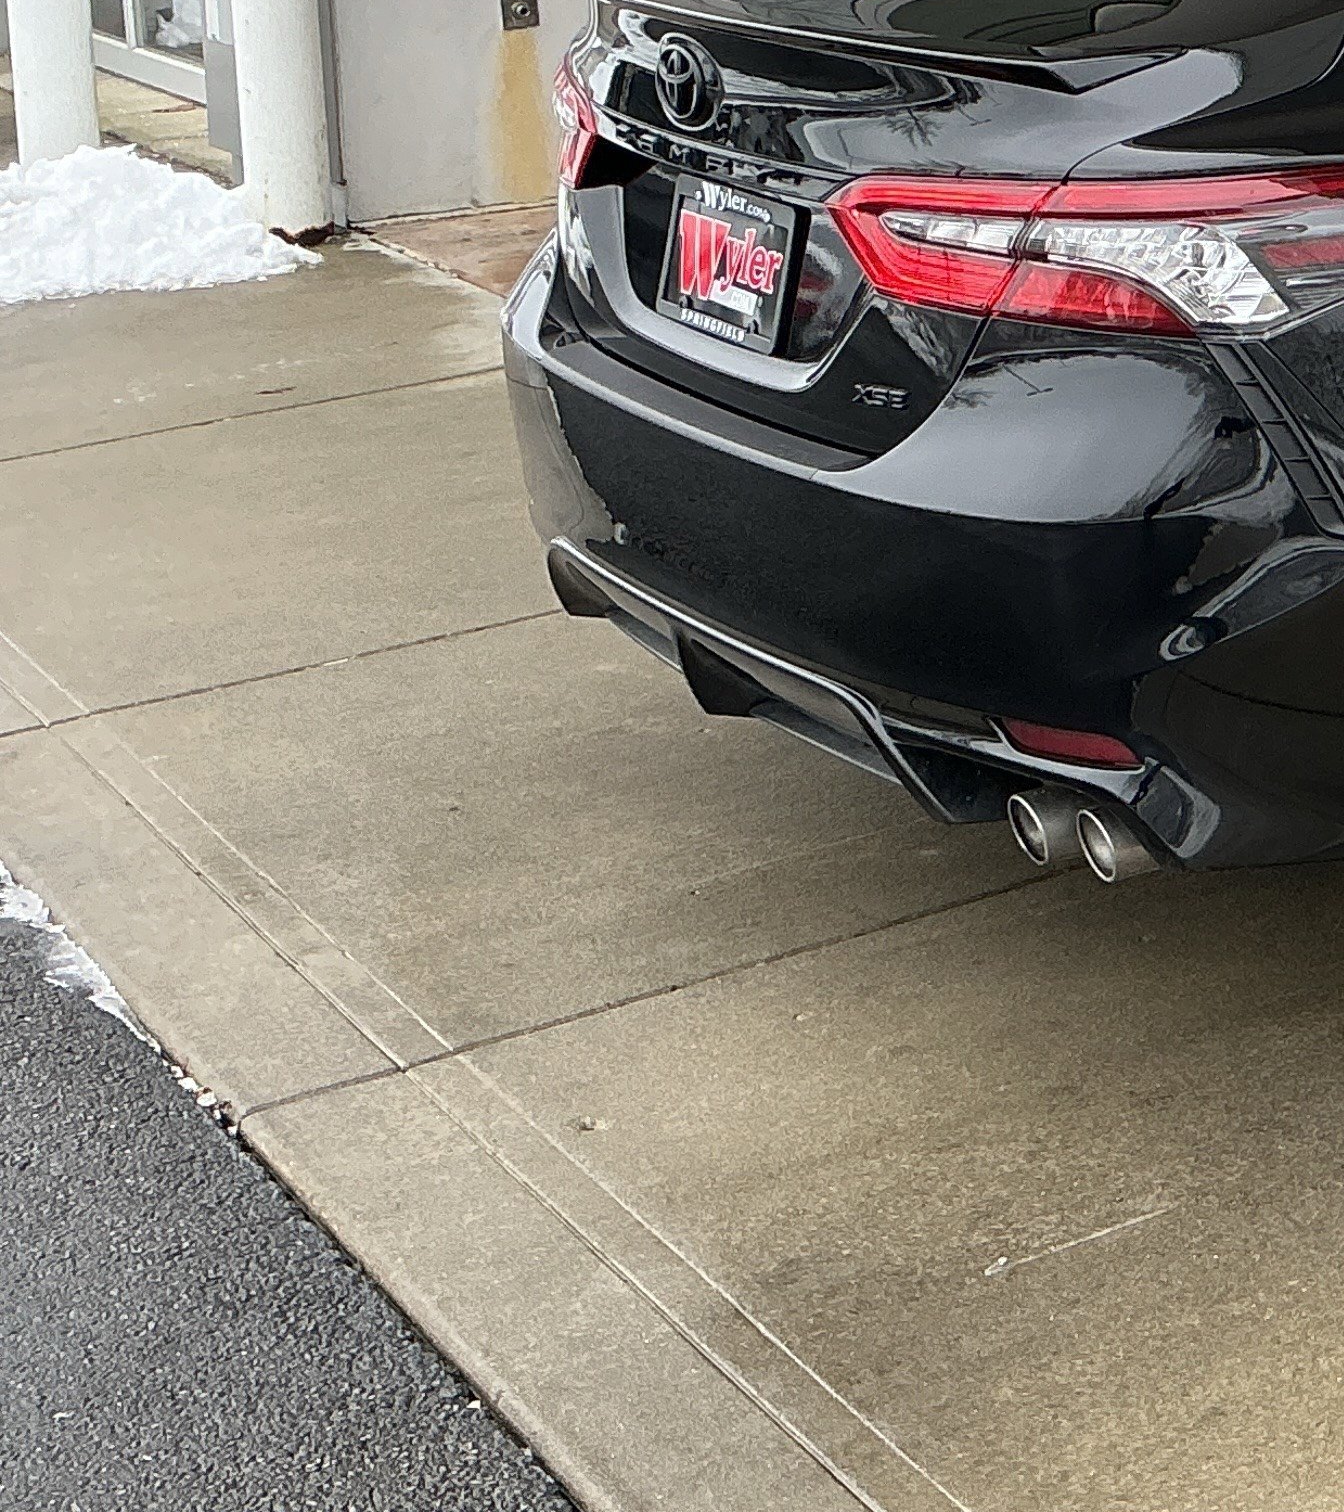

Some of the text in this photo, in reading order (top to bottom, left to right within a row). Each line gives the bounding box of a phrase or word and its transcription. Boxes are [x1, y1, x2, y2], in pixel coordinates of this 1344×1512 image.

[680, 207, 784, 301] Wyler
[680, 307, 745, 342] SPRINGFIELD
[851, 383, 908, 409] XSE
